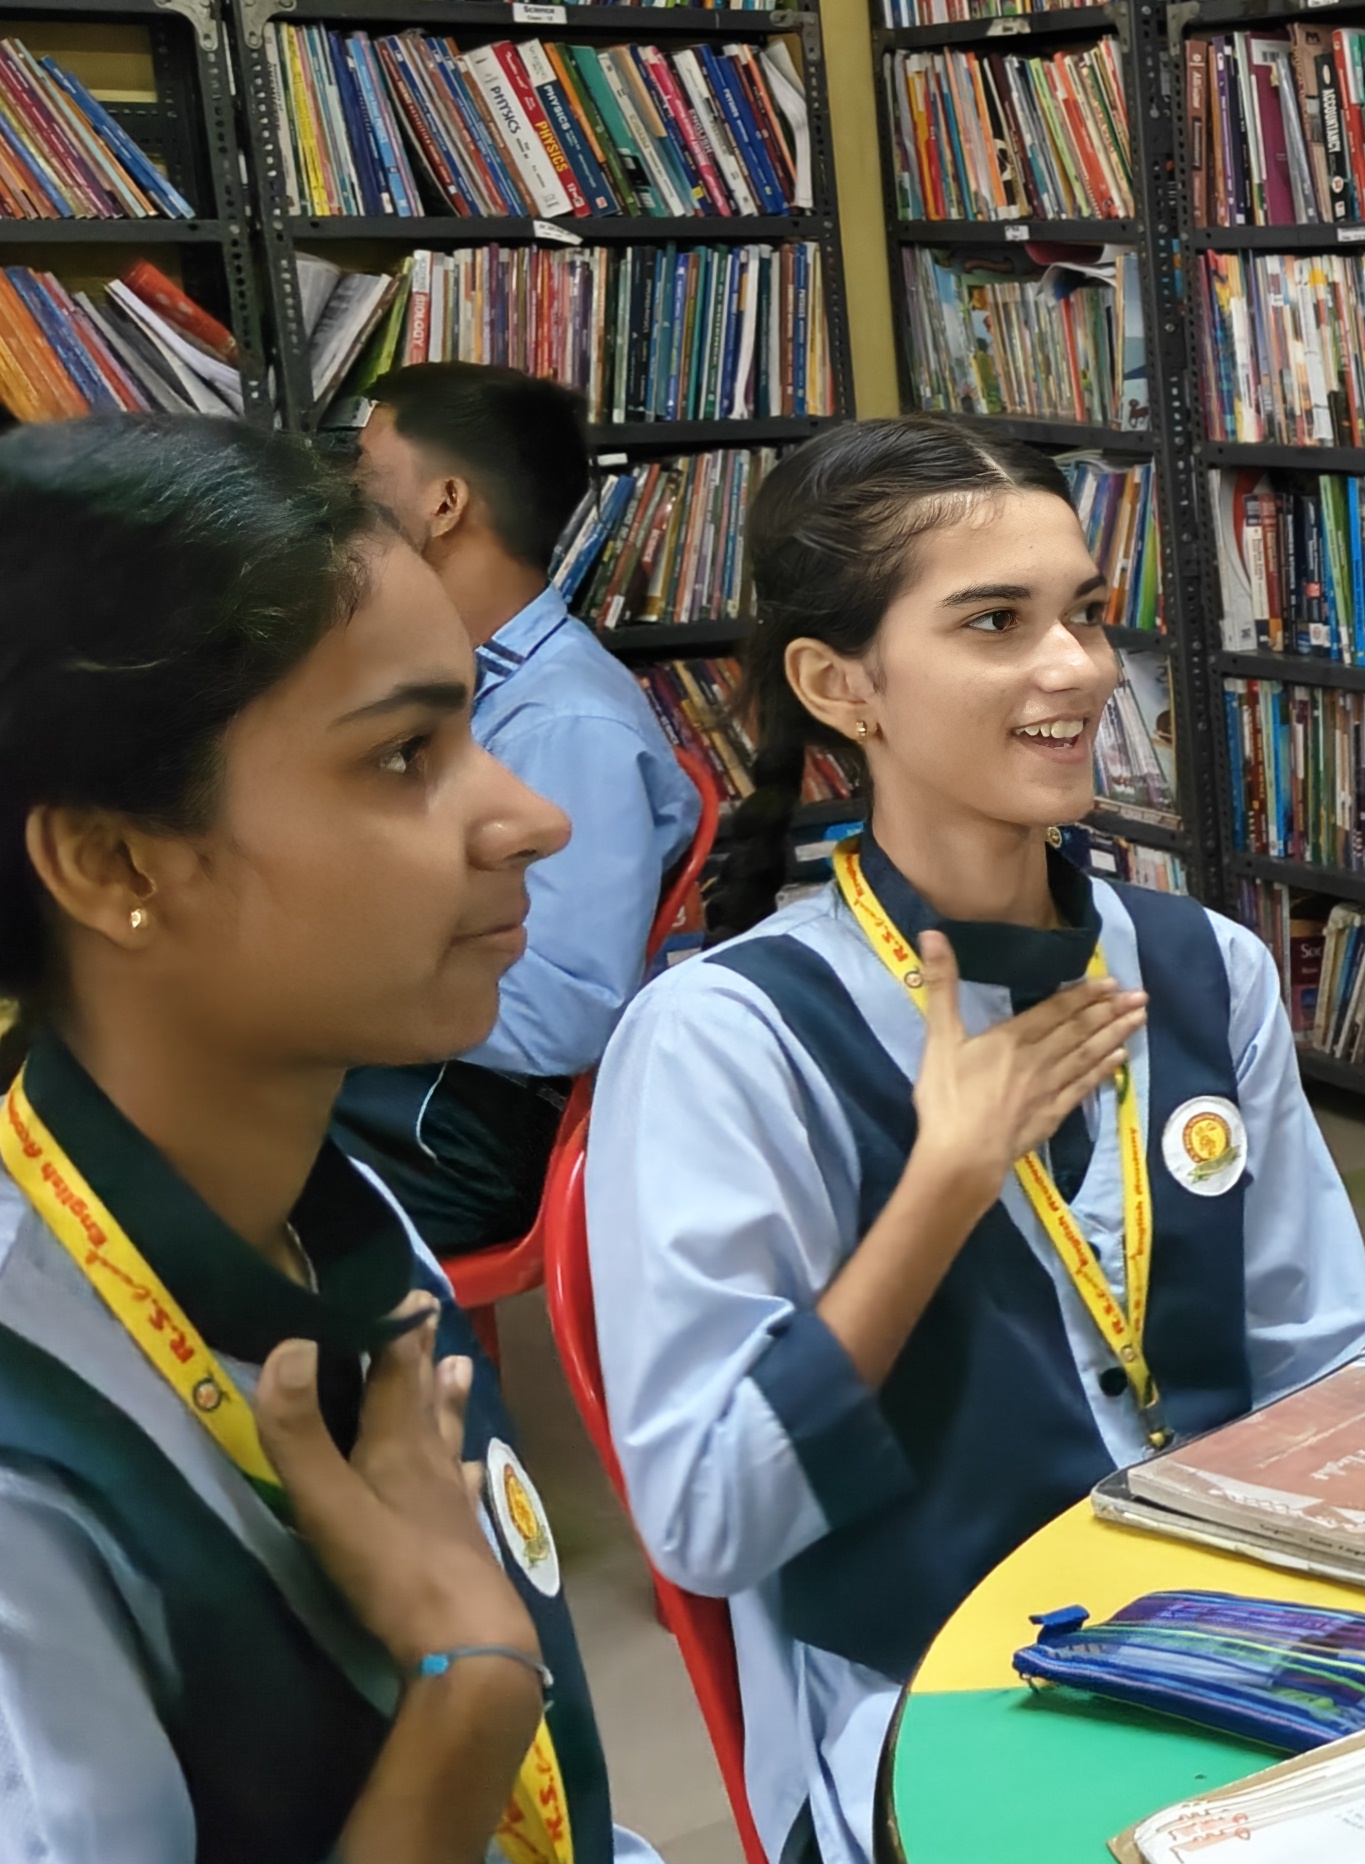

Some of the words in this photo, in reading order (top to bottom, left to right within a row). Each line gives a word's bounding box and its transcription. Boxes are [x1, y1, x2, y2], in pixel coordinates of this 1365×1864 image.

[490, 86, 521, 135] PHYSICS
[543, 84, 570, 132] PHYSICS
[1321, 88, 1341, 153] ACCOUNTANCY
[535, 120, 568, 173] PHYSICS
[412, 291, 424, 347] BIOLOGY
[877, 923, 909, 963] R.S.
[42, 1162, 107, 1248] English
[1135, 1200, 1147, 1257] English
[1058, 1214, 1089, 1267] English
[148, 1299, 195, 1364] R.S.
